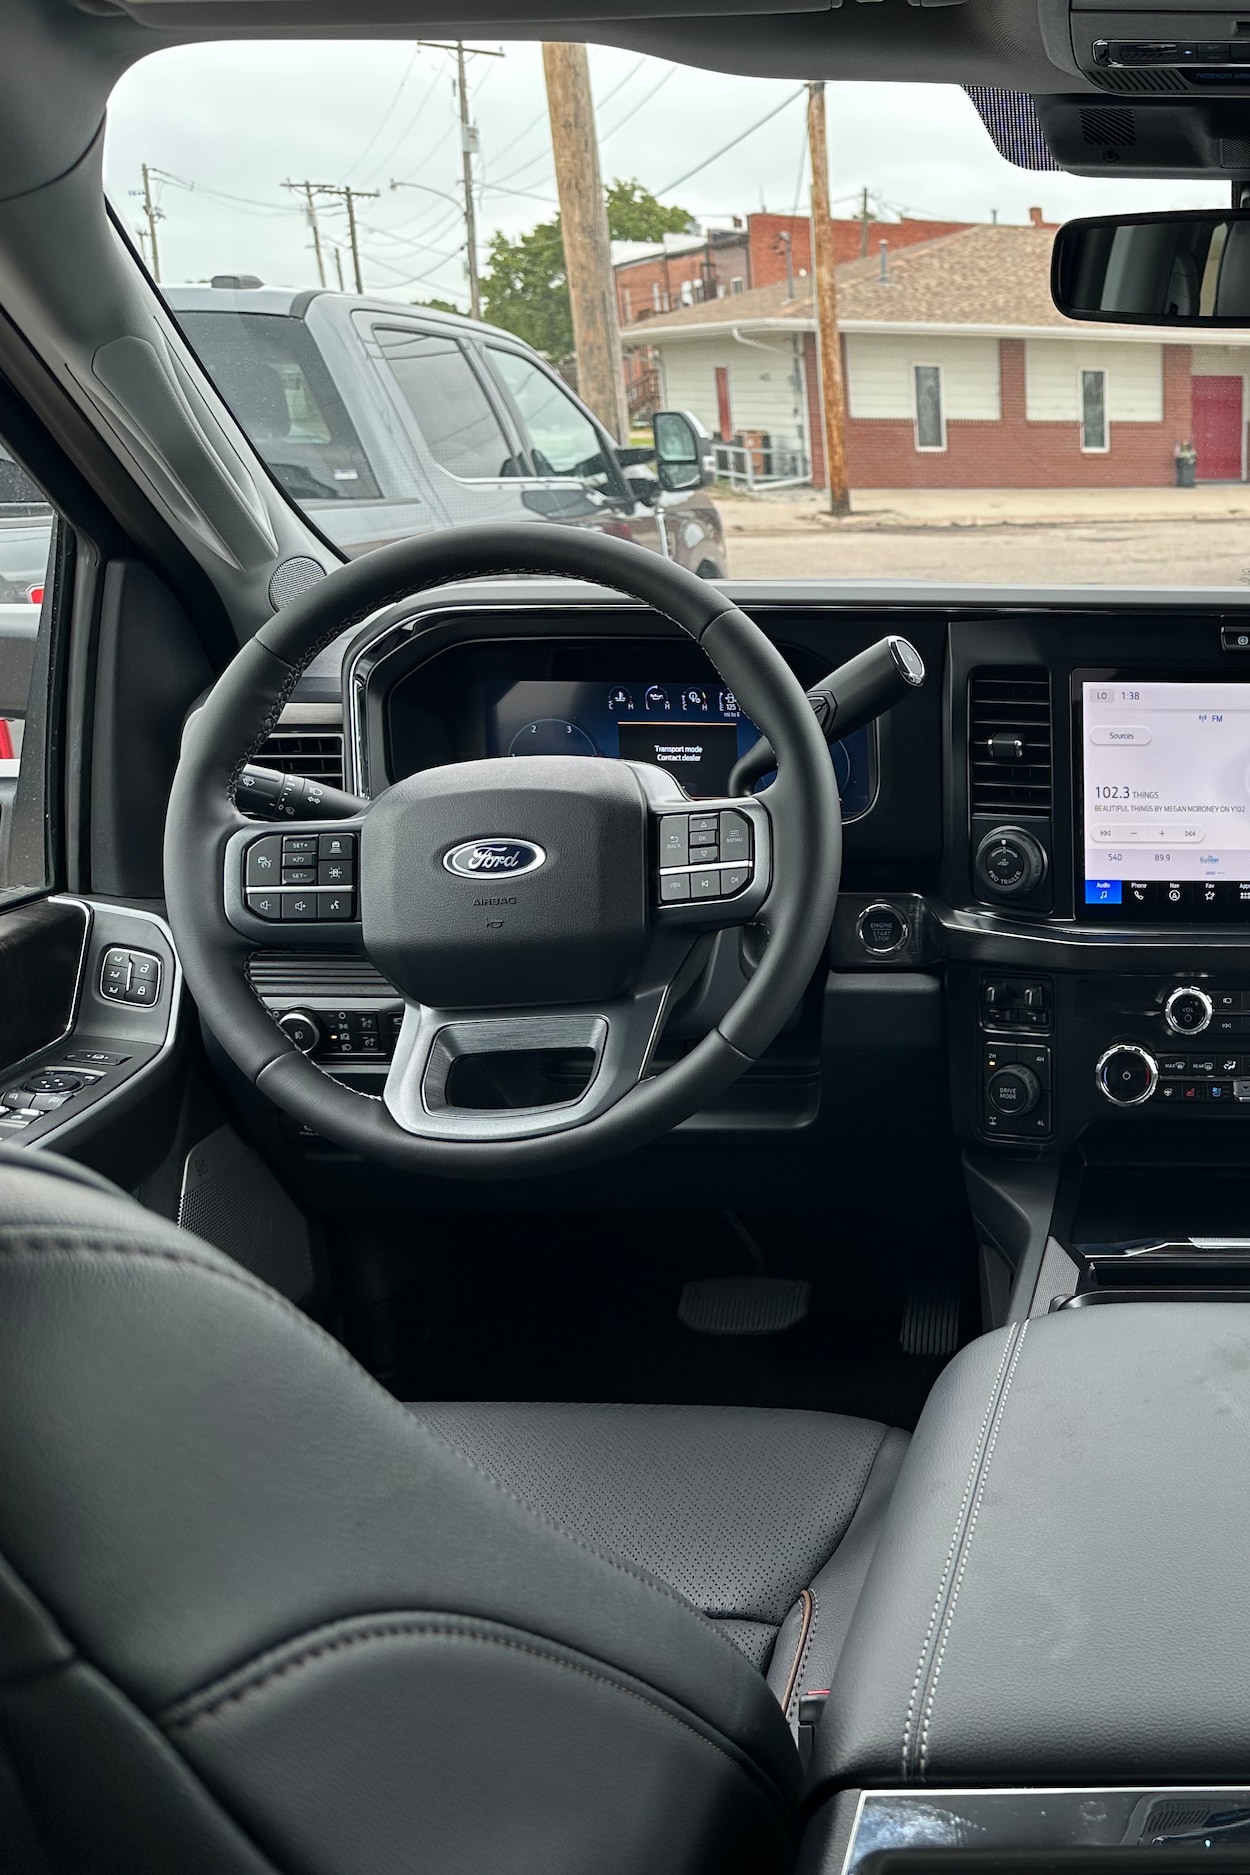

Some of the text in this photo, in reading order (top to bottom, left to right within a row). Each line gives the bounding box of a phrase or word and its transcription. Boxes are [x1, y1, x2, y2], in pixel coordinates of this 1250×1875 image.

[1097, 692, 1140, 700] LO 1:38
[531, 725, 537, 733] 2
[567, 725, 572, 733] 3
[1109, 732, 1134, 740] Sources
[654, 745, 684, 754] Transport
[682, 754, 702, 762] dealer
[1095, 786, 1130, 799] 102.3
[468, 847, 520, 869] Ford
[988, 869, 1021, 885] PRO TRAILER
[473, 897, 517, 906] AIRBAG
